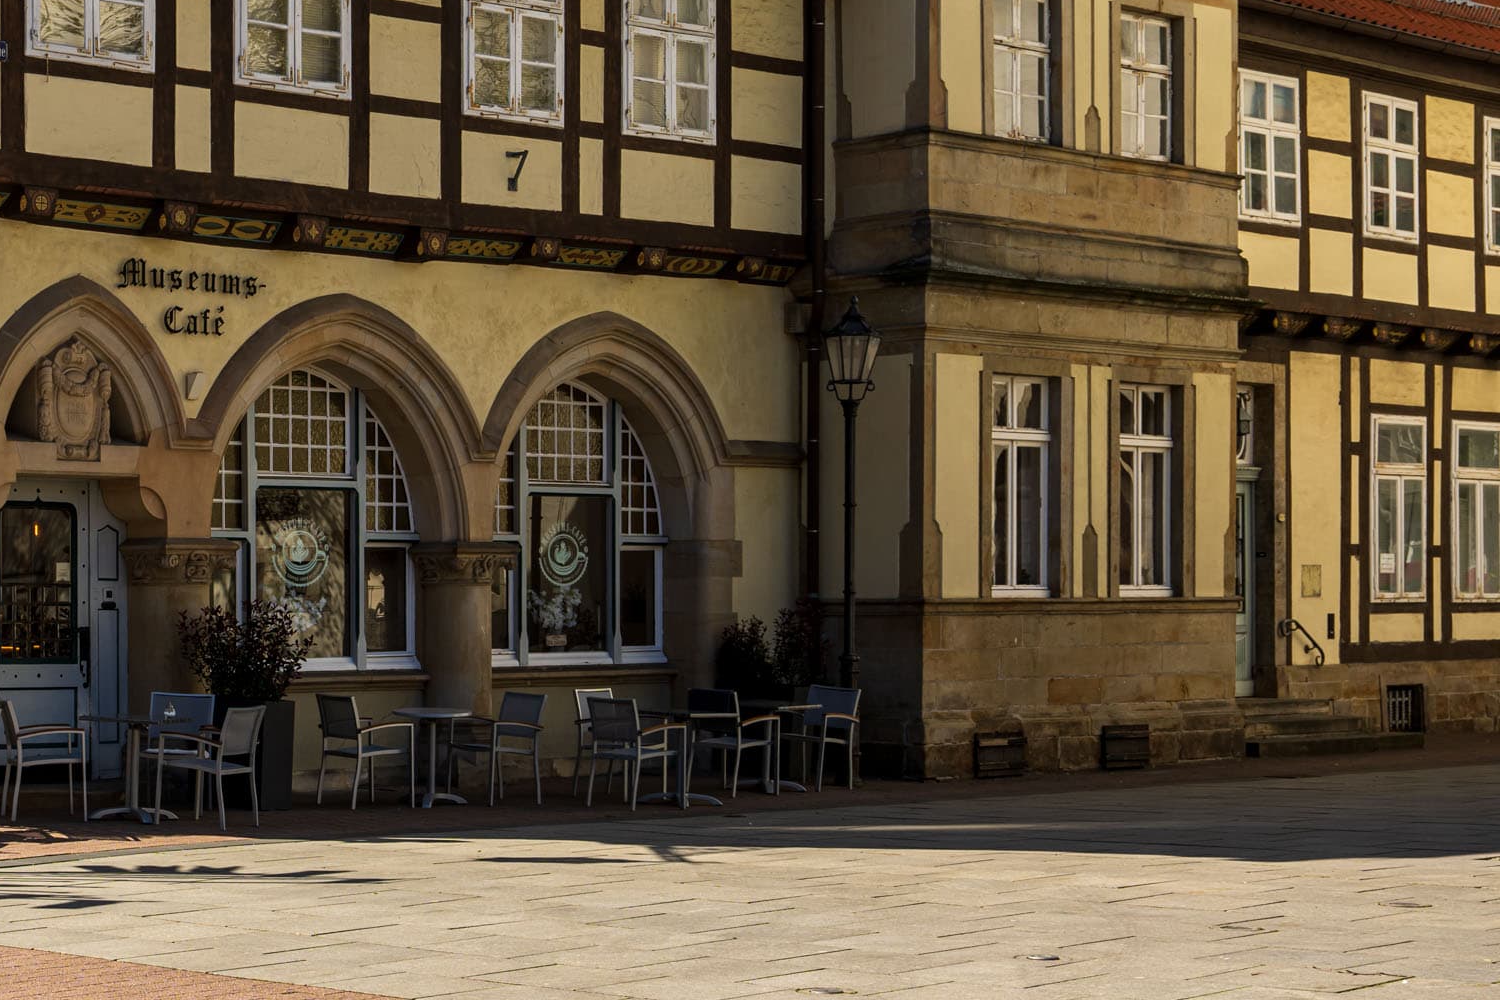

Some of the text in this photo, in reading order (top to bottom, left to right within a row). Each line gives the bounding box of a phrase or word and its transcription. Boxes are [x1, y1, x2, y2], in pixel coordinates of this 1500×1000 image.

[505, 150, 529, 191] 7
[116, 257, 267, 299] Museums-
[163, 305, 226, 337] Café
